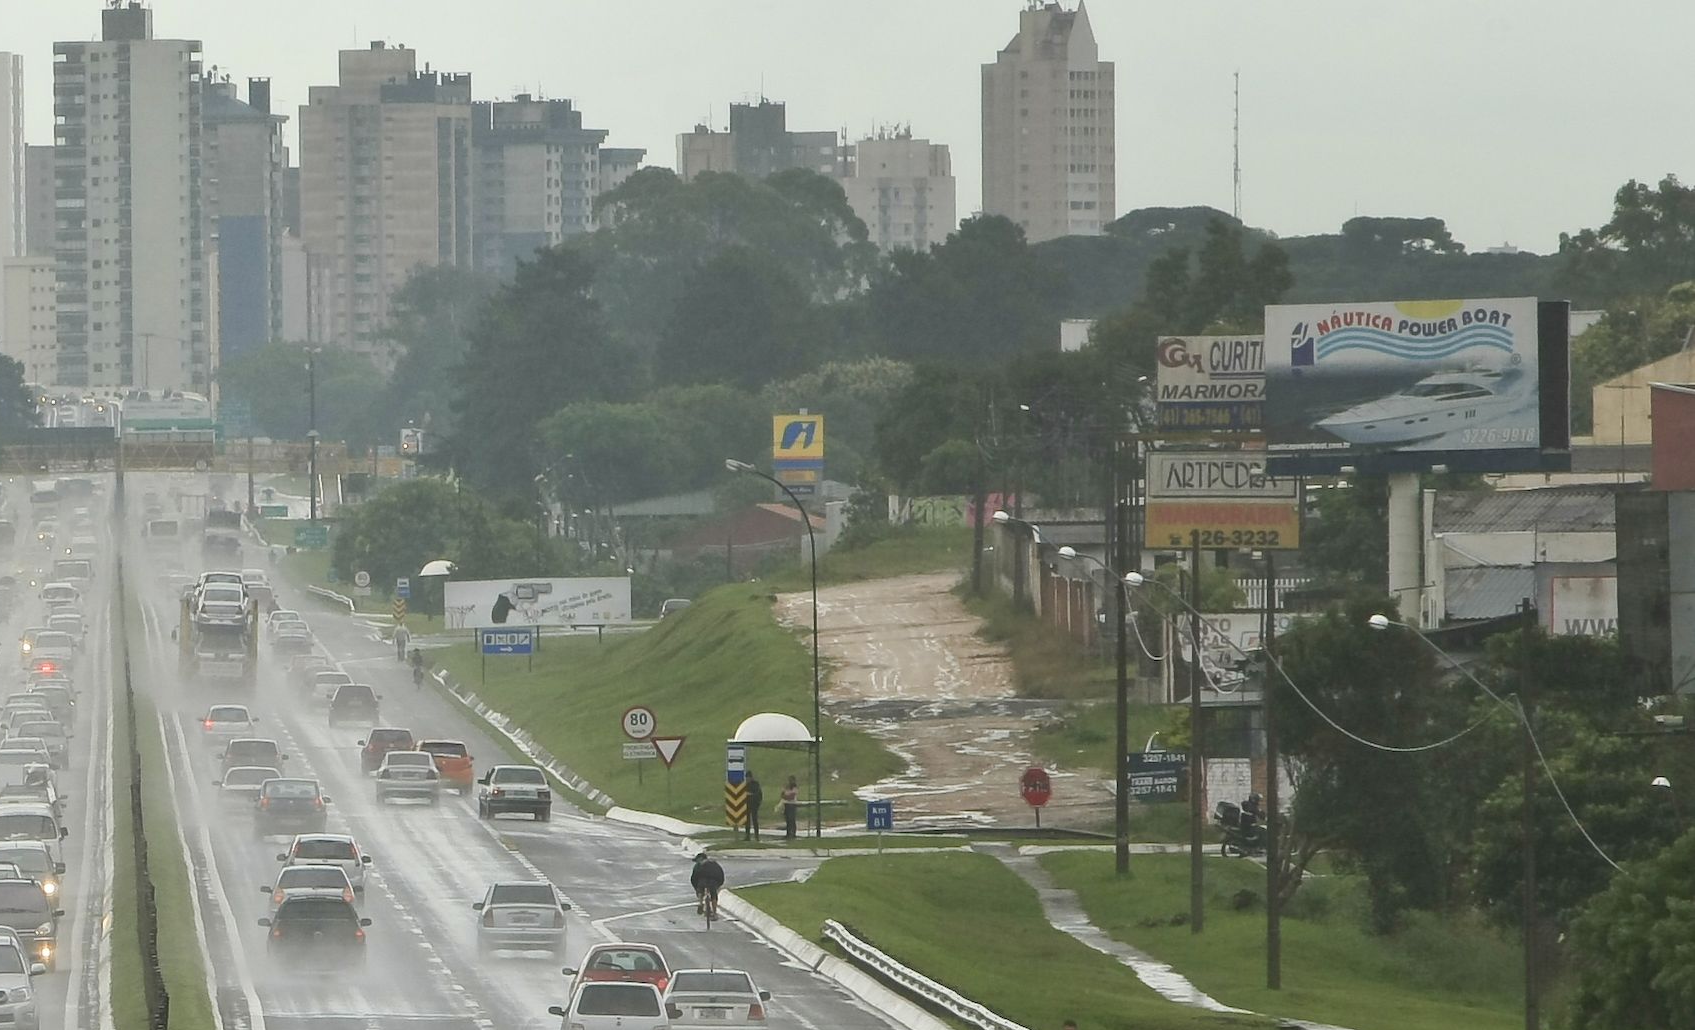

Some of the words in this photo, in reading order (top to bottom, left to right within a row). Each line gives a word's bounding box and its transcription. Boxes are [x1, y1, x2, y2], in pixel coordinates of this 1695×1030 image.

[1316, 310, 1393, 336] NÁUTICA
[1398, 317, 1458, 337] POWER
[1461, 308, 1512, 328] BOAT
[1209, 340, 1266, 372] CURITI
[1189, 529, 1280, 546] 26-3232
[630, 713, 648, 726] 80
[873, 817, 886, 828] 81
